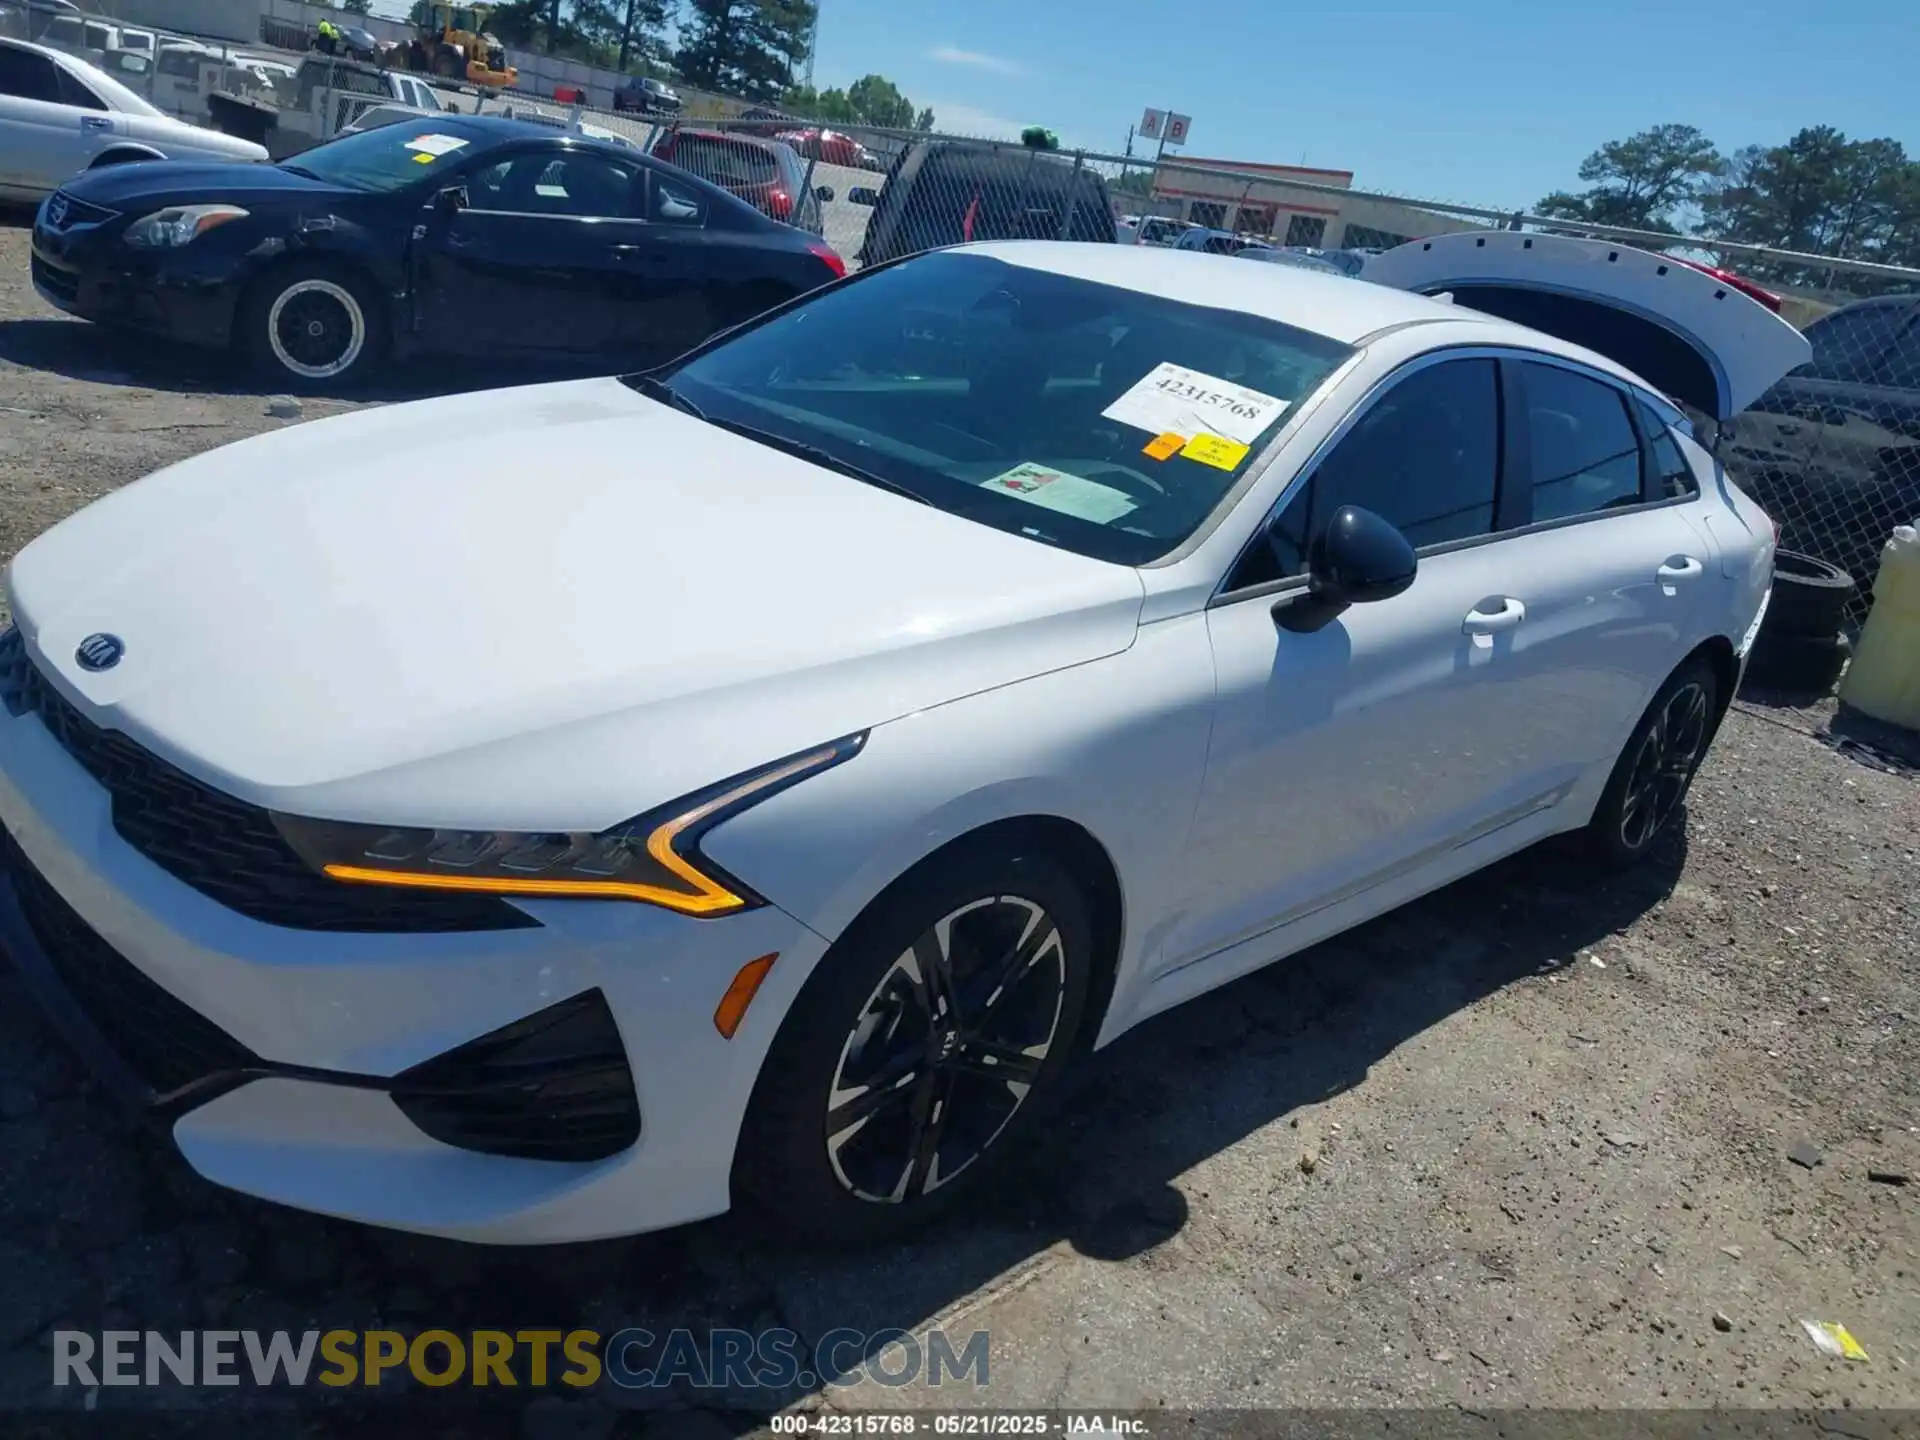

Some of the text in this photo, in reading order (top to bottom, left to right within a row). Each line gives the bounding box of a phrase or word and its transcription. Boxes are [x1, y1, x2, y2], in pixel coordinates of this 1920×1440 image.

[1145, 115, 1156, 132] A
[1171, 121, 1184, 137] B
[1155, 377, 1261, 420] 42315768
